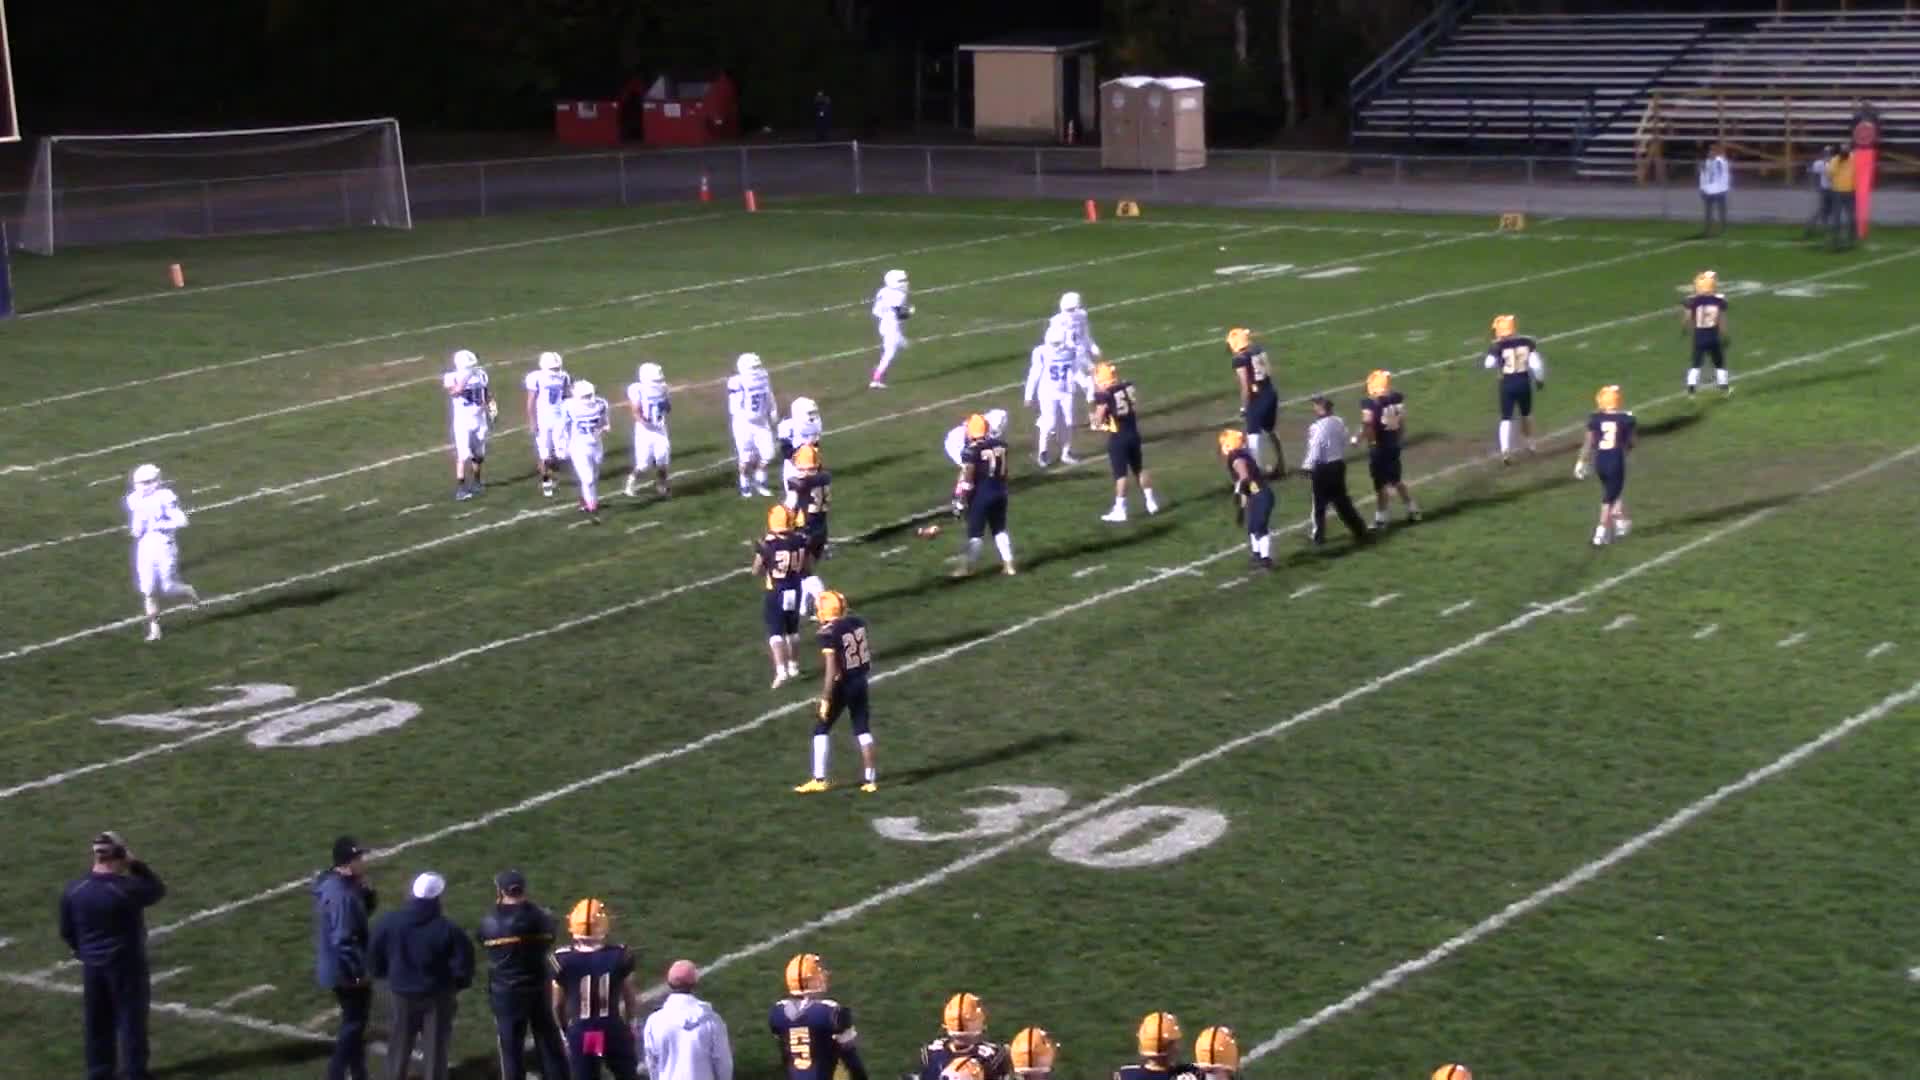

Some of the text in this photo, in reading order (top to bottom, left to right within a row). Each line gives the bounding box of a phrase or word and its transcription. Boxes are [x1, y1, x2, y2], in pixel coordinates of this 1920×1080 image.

[1600, 421, 1617, 450] 3
[842, 627, 870, 669] 22
[90, 683, 422, 747] 20
[872, 785, 1227, 867] 30
[580, 975, 610, 1019] 11
[789, 1027, 812, 1070] 5
